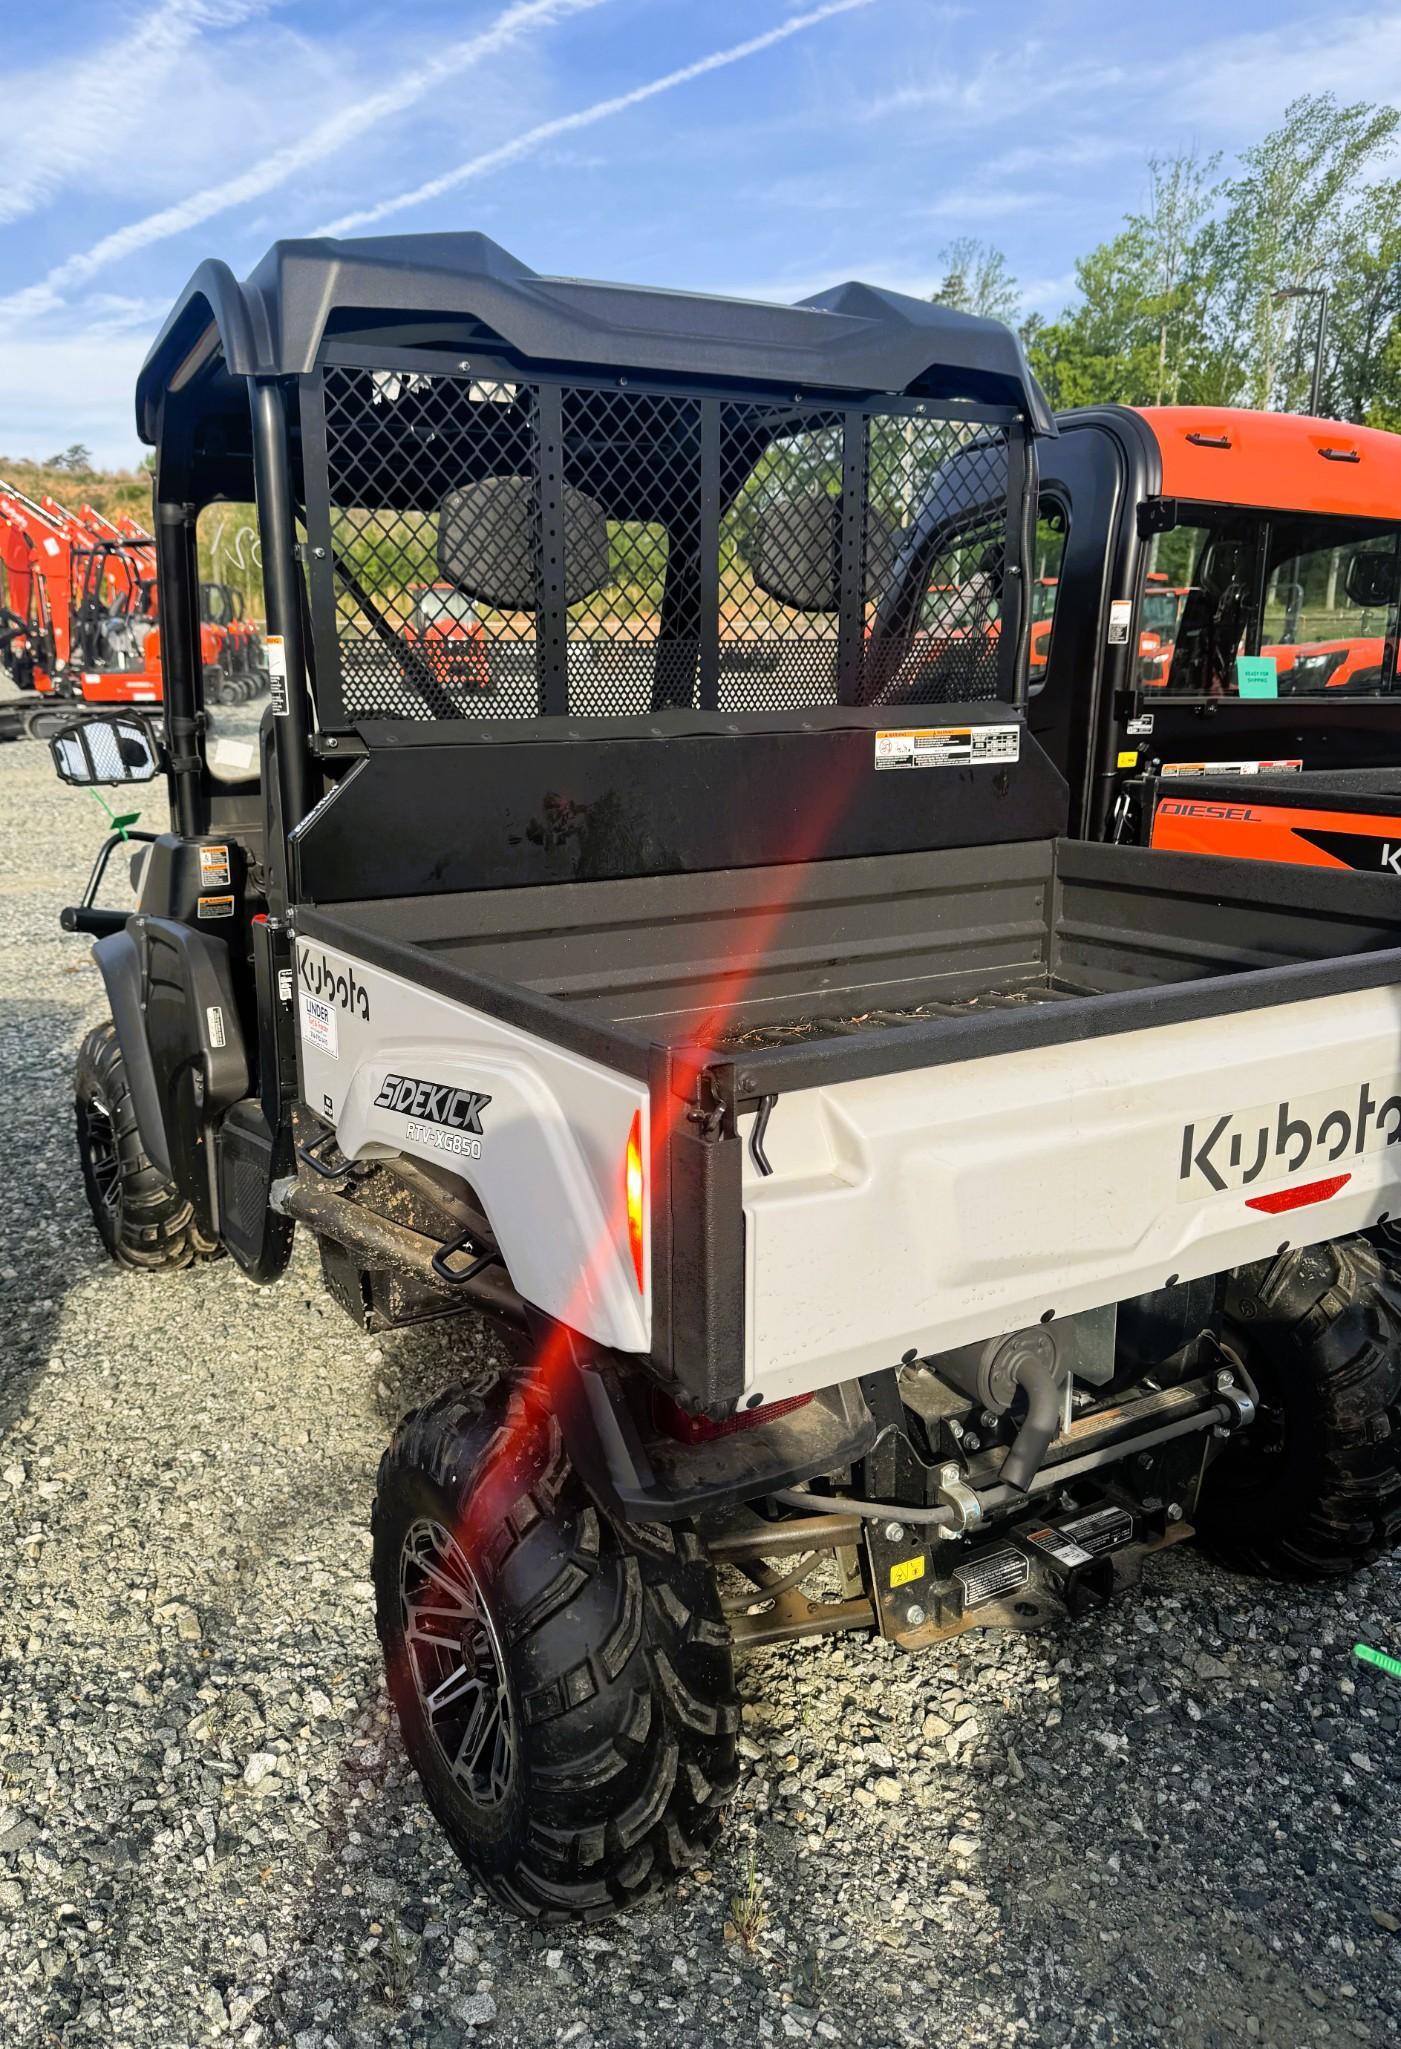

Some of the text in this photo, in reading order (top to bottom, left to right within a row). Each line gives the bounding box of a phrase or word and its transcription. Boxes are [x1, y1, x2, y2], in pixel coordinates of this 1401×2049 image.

[1160, 803, 1262, 823] DIESEL
[297, 944, 370, 1021] Kubota
[306, 998, 329, 1023] LINDER
[374, 1073, 493, 1135] SIDEKICK
[405, 1121, 482, 1161] RTV-XG850
[1179, 1082, 1401, 1191] Kubota
